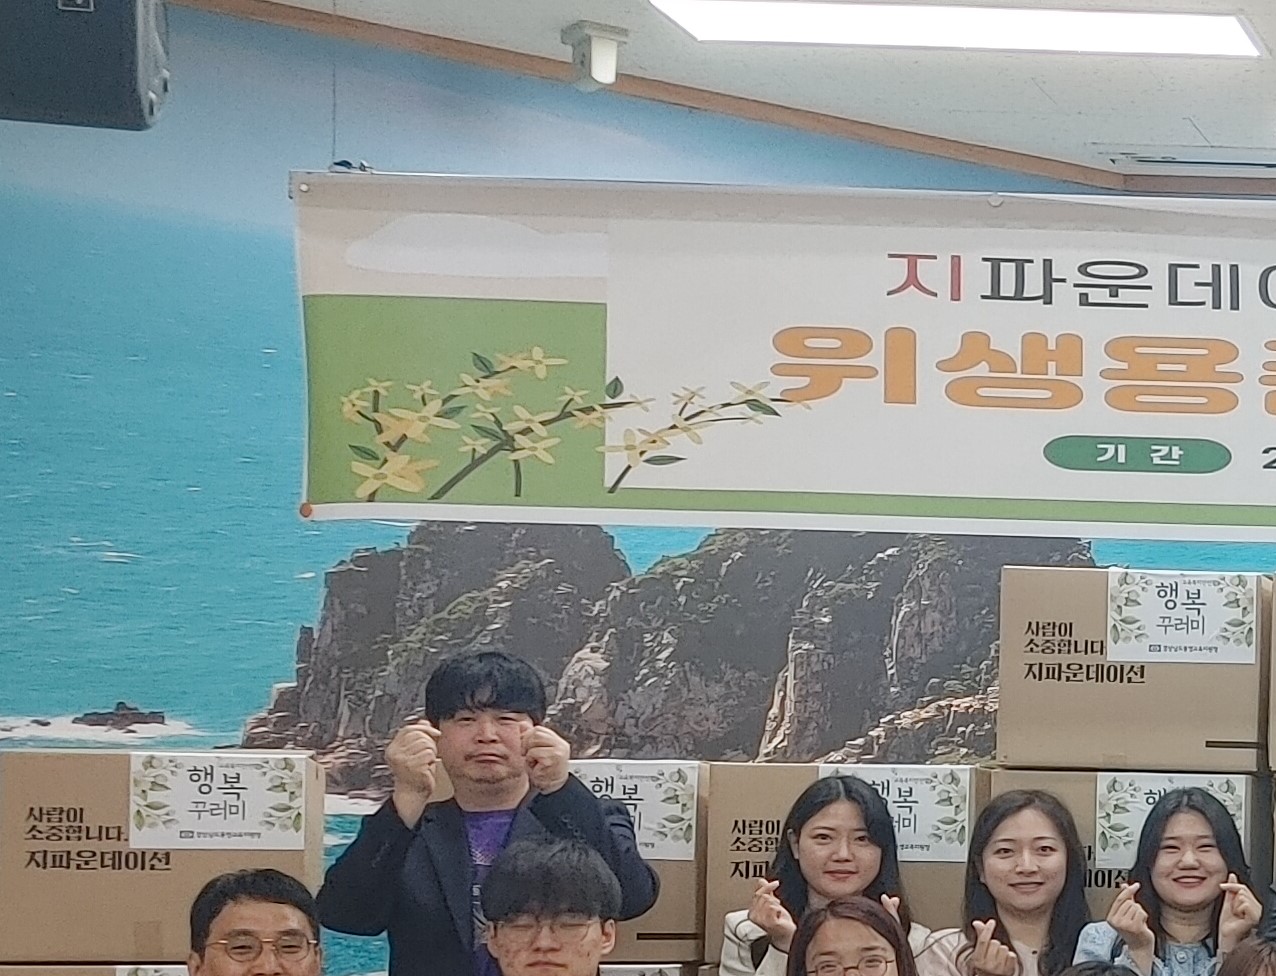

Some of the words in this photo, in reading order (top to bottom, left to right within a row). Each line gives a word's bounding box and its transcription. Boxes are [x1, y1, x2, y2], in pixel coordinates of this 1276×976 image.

[1155, 580, 1206, 616] 행복
[1023, 620, 1074, 638] 사람이
[1156, 615, 1205, 636] 꾸러미
[1023, 662, 1146, 684] 지파운데이션
[187, 765, 248, 801] 행복
[27, 806, 84, 824] 사람이
[188, 800, 246, 821] 꾸러미
[25, 824, 129, 842] 소중합니다.
[731, 819, 780, 836] 사람이
[730, 837, 779, 854] 소중합
[25, 850, 172, 871] 지파운데이션
